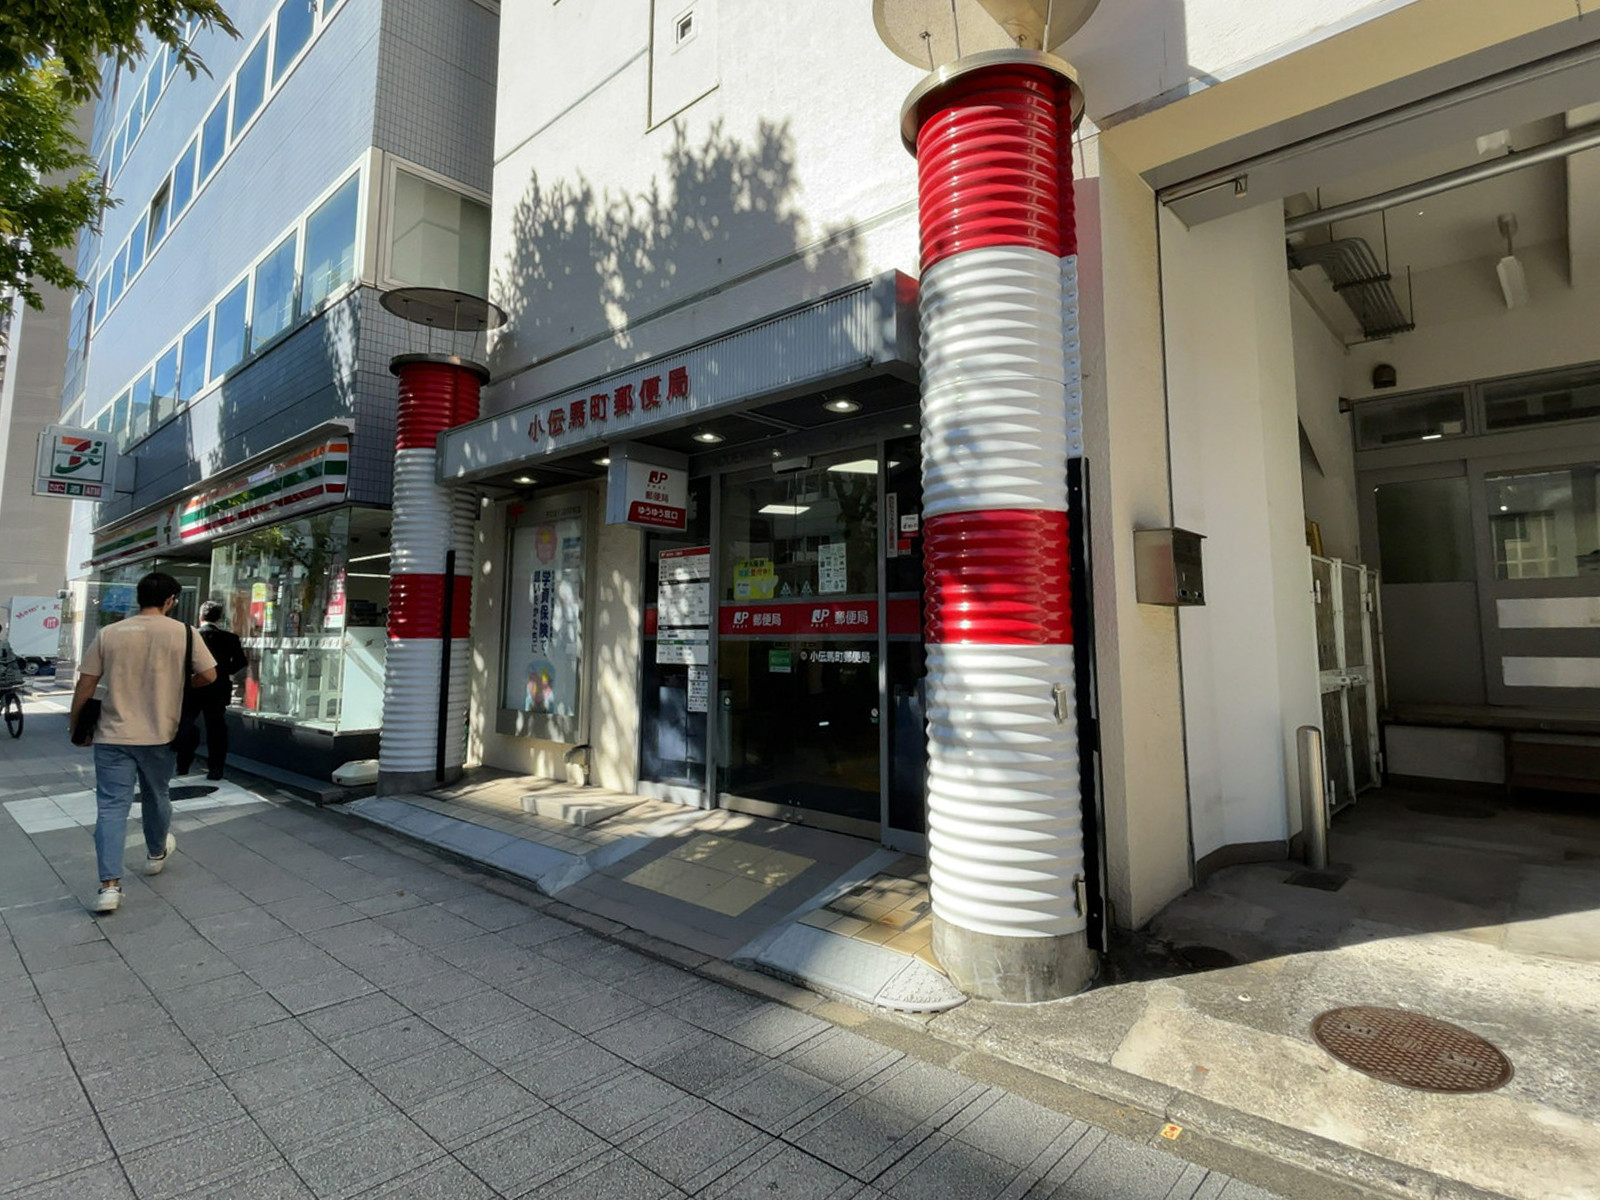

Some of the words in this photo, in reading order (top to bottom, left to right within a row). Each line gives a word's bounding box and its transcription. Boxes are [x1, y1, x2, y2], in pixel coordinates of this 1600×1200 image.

[528, 366, 690, 442] 小伝馬町郵便局
[645, 491, 669, 503] 郵便局
[637, 505, 680, 521] ゆうゆう窓口
[752, 612, 782, 626] 郵便局
[834, 610, 869, 625] 郵便局
[810, 651, 870, 664] 小伝馬町郵便局
